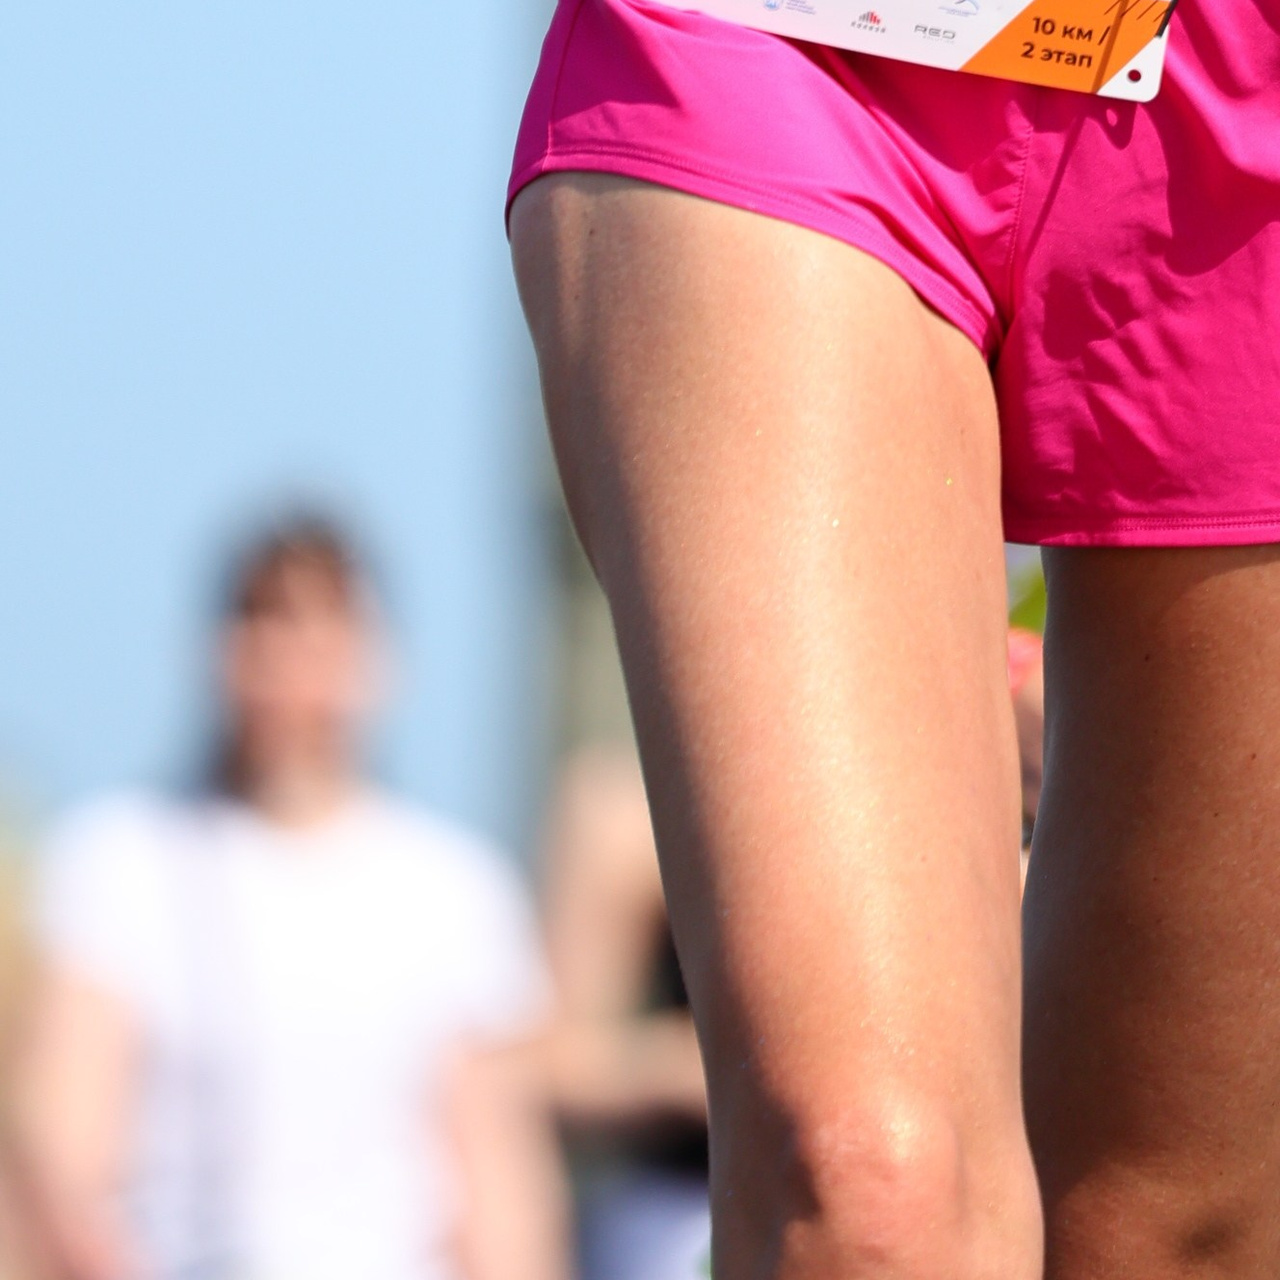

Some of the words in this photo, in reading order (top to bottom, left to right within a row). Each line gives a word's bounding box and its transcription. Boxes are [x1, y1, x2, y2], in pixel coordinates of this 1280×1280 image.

[1032, 16, 1055, 36] 10
[1061, 25, 1094, 43] км
[1020, 42, 1035, 59] 2
[1040, 48, 1093, 69] этап
